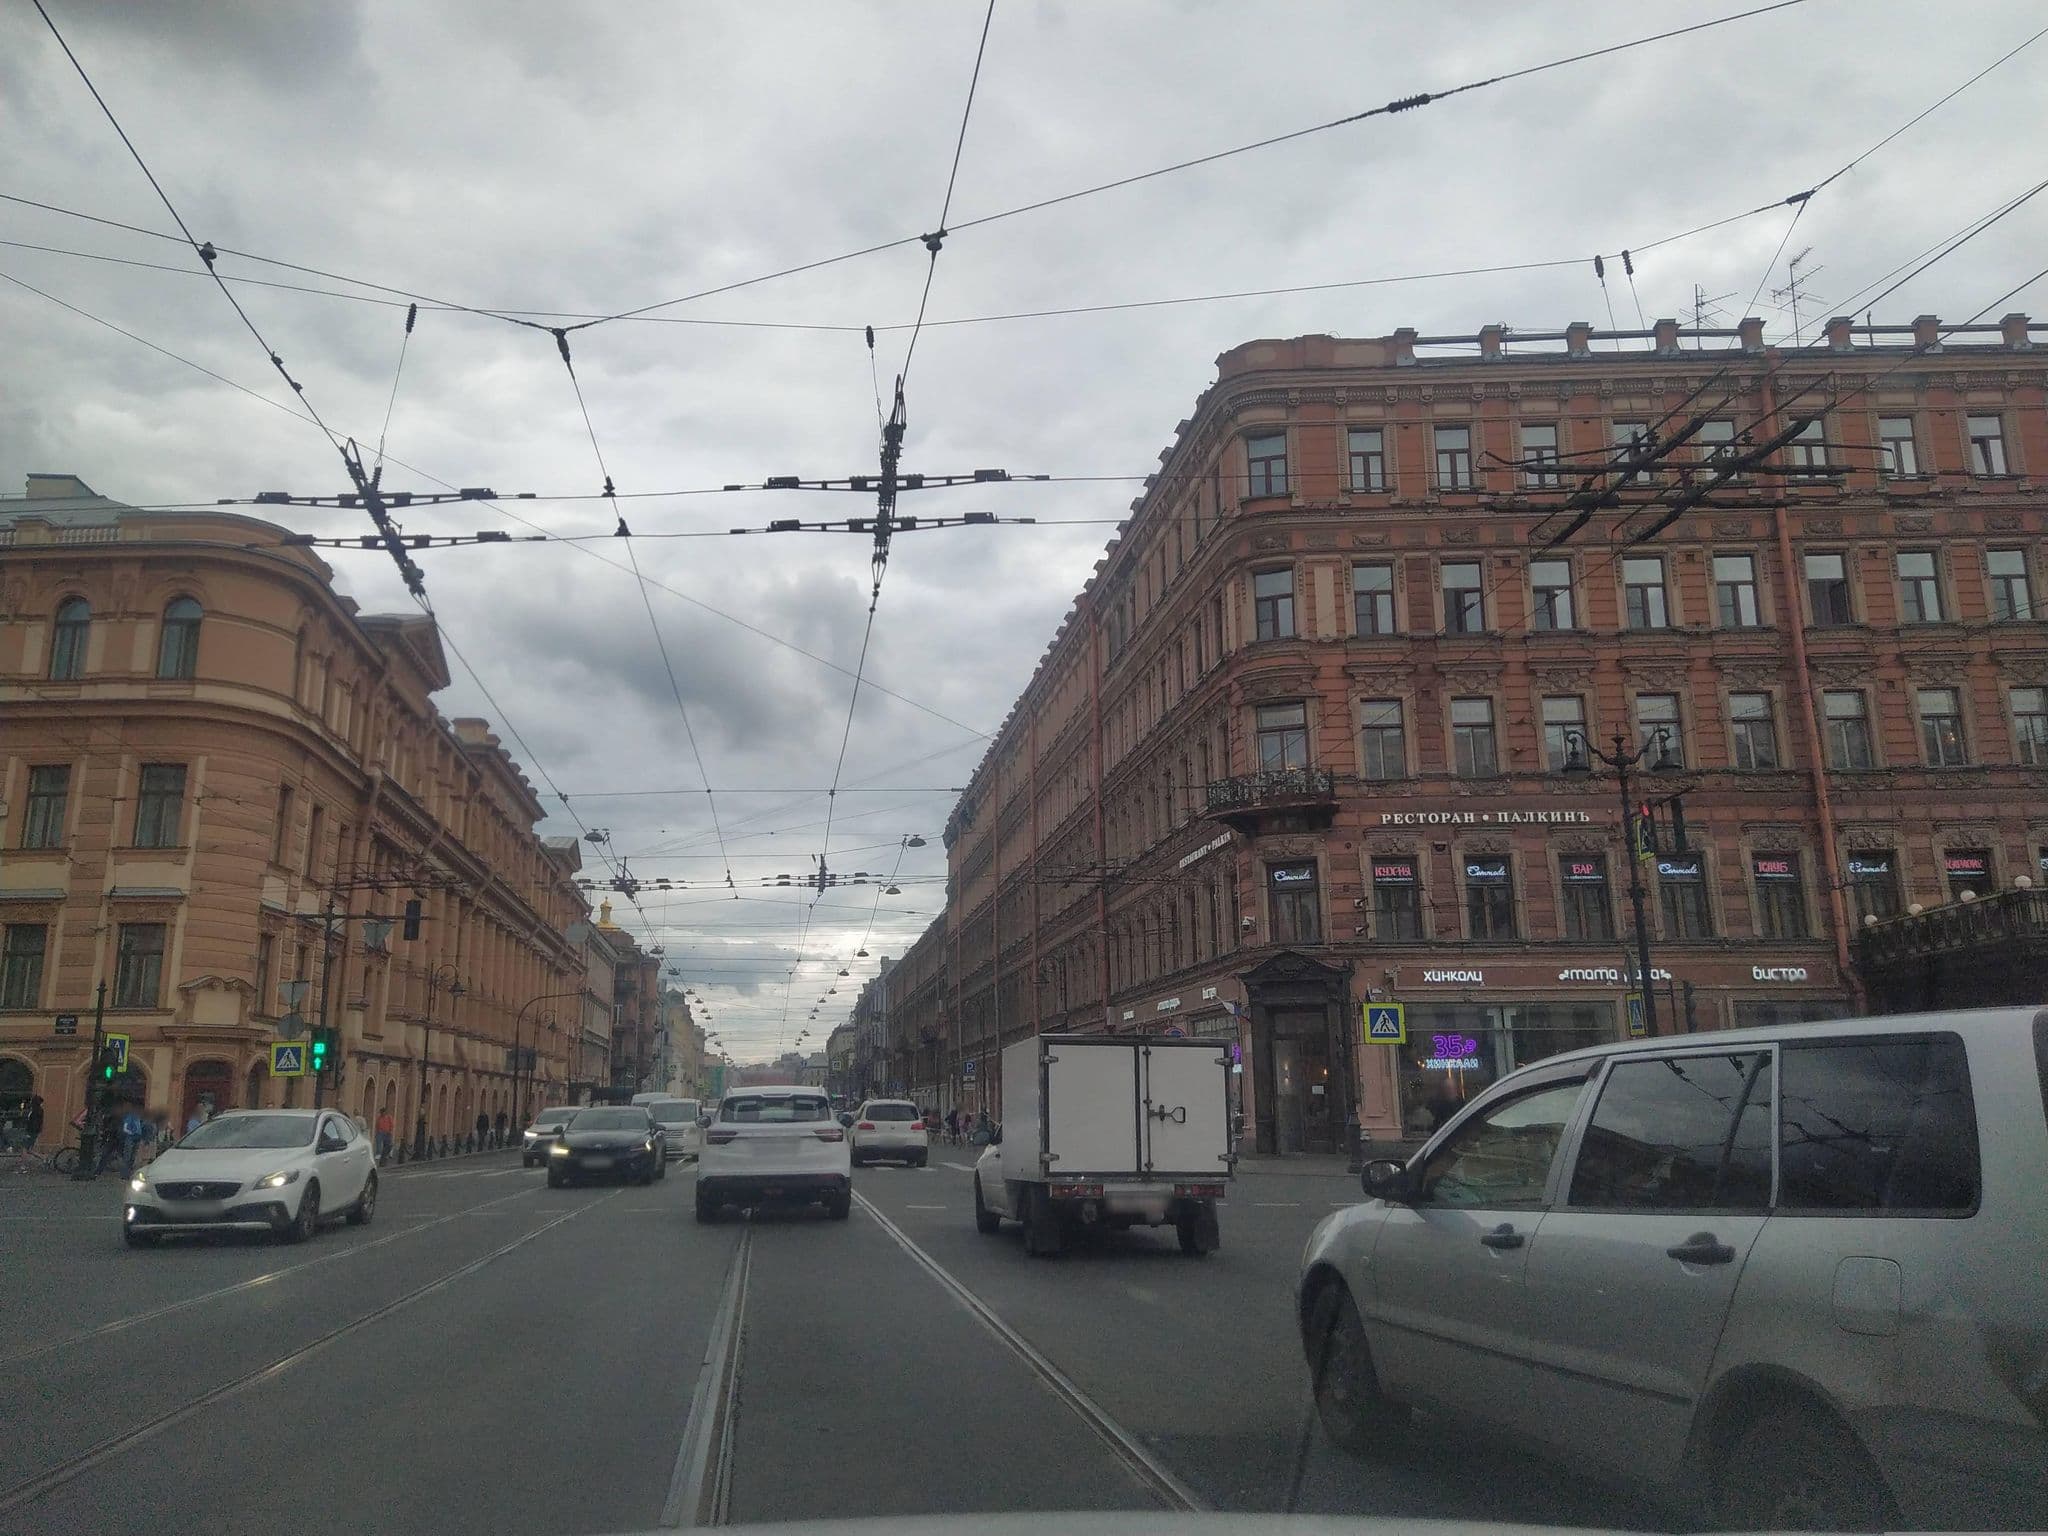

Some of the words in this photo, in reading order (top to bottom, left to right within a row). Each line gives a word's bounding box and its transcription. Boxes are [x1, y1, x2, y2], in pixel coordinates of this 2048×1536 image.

[1381, 812, 1475, 825] РЕСТОРАН
[1497, 811, 1590, 823] ПАЛКИНЪ
[1571, 863, 1594, 874] БАР
